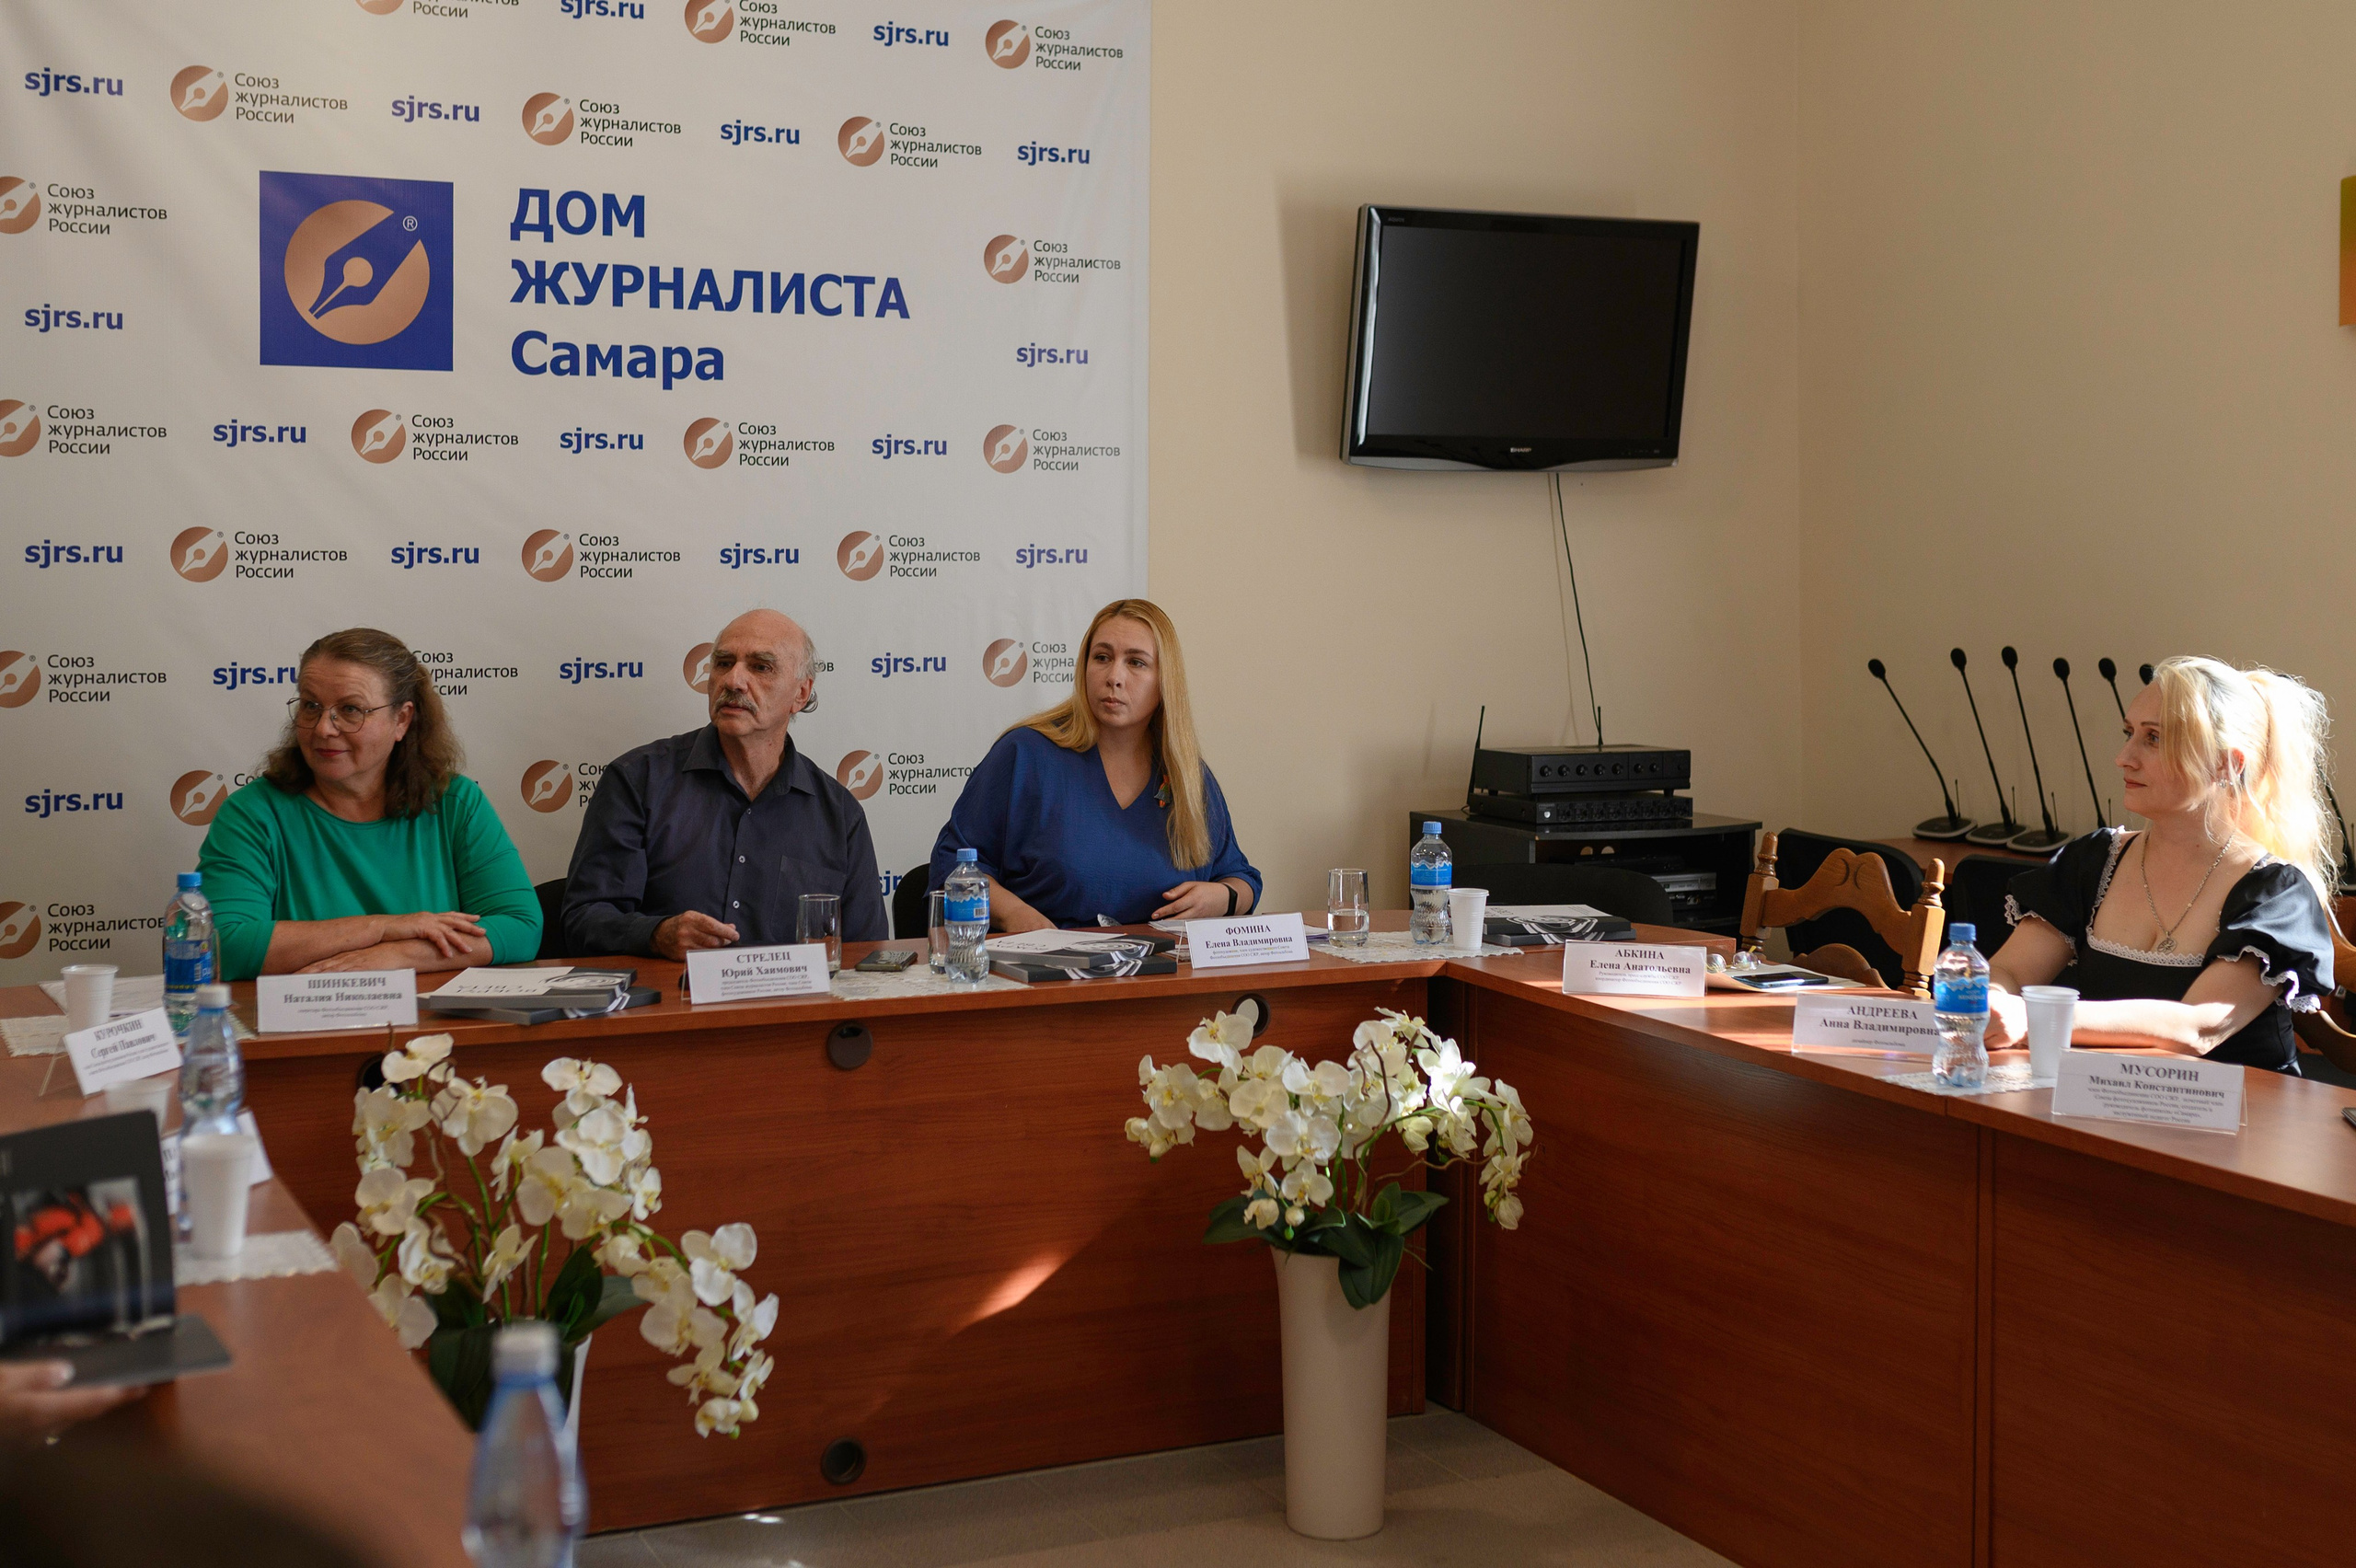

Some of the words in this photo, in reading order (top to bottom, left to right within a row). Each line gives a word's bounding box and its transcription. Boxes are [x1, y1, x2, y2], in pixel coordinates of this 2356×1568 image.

[414, 1, 468, 17] России
[740, 17, 836, 34] журналистов
[741, 30, 790, 46] России
[874, 21, 948, 46] sjrs.ru
[1035, 27, 1069, 40] Союз
[1036, 43, 1123, 58] журналистов
[1036, 56, 1080, 70] России
[26, 67, 122, 97] sjrs.ru
[235, 74, 279, 88] Союз
[236, 92, 347, 110] журналистов
[580, 99, 619, 114] Союз
[237, 107, 294, 123] России
[392, 96, 479, 122] sjrs.ru
[581, 118, 681, 135] журналистов
[721, 120, 799, 145] sjrs.ru
[890, 123, 926, 136] Союз
[582, 132, 632, 146] России
[890, 140, 981, 155] журналистов
[1018, 142, 1090, 166] sjrs.ru
[891, 154, 937, 167] России
[48, 184, 94, 199] Союз
[49, 203, 167, 219] журналистов
[511, 189, 644, 243] ДОМ
[50, 218, 110, 235] России
[1034, 240, 1068, 253] Союз
[1034, 257, 1120, 271] журналистов
[1035, 270, 1079, 282] России
[510, 259, 910, 318] ЖУРНАЛИСТА
[25, 304, 122, 332] sjrs.ru
[512, 330, 723, 390] Самара
[1017, 342, 1088, 367] sjrs.ru
[48, 405, 94, 420] Союз
[412, 415, 454, 428] Союз
[739, 422, 776, 434] Союз
[48, 425, 167, 439] журналистов
[214, 420, 306, 447] sjrs.ru
[1033, 429, 1067, 441] Союз
[413, 433, 518, 446] журналистов
[560, 428, 643, 454] sjrs.ru
[739, 440, 834, 453] журналистов
[872, 434, 946, 459] sjrs.ru
[50, 440, 110, 454] России
[414, 447, 468, 460] России
[1034, 446, 1120, 458] журналистов
[740, 454, 789, 466] России
[1034, 459, 1078, 470] России
[235, 532, 279, 544] Союз
[580, 534, 618, 546] Союз
[889, 536, 924, 547] Союз
[25, 540, 122, 569] sjrs.ru
[236, 550, 347, 564] журналистов
[392, 542, 479, 569] sjrs.ru
[580, 552, 680, 565] журналистов
[721, 543, 799, 569] sjrs.ru
[890, 552, 980, 564] журналистов
[1016, 544, 1087, 569] sjrs.ru
[237, 565, 294, 578] России
[581, 566, 631, 578] России
[891, 565, 936, 577] России
[1033, 642, 1066, 653] Союз
[48, 654, 94, 668] Союз
[872, 652, 946, 677] sjrs.ru
[560, 658, 642, 684] sjrs.ru
[48, 673, 167, 688] журналистов
[50, 689, 110, 702] России
[888, 753, 924, 765] Союз
[888, 767, 976, 782] журналисто
[890, 783, 936, 795] России
[26, 789, 122, 818] sjrs.ru
[48, 904, 94, 917] Союз
[1225, 925, 1271, 935] ФОМИНА
[50, 939, 110, 951] России
[1206, 940, 1231, 949] Елена
[1232, 936, 1293, 948] Владимировна
[736, 951, 791, 963] СТРЕЛЕЦ
[1614, 949, 1665, 960] АБКИНА
[722, 967, 753, 979] Юрий
[756, 965, 807, 975] Хаимович
[1590, 960, 1621, 970] Елена
[1623, 963, 1691, 974] Анатольевна
[307, 977, 387, 989] ШИНКЕВИЧ
[283, 994, 332, 1004] Наталия
[335, 992, 403, 1002] Николаевна
[1847, 1006, 1918, 1020] АНДРЕЕВА
[93, 1019, 143, 1042] КУРОЧКИН
[1819, 1018, 1850, 1029] Анна
[1853, 1019, 1940, 1037] Владимировна
[90, 1043, 118, 1059] Сергей
[119, 1033, 156, 1051] Павлович
[2119, 1063, 2200, 1082] МУСОРИН
[2088, 1075, 2131, 1089] Михаил
[2134, 1079, 2225, 1099] Константинович
